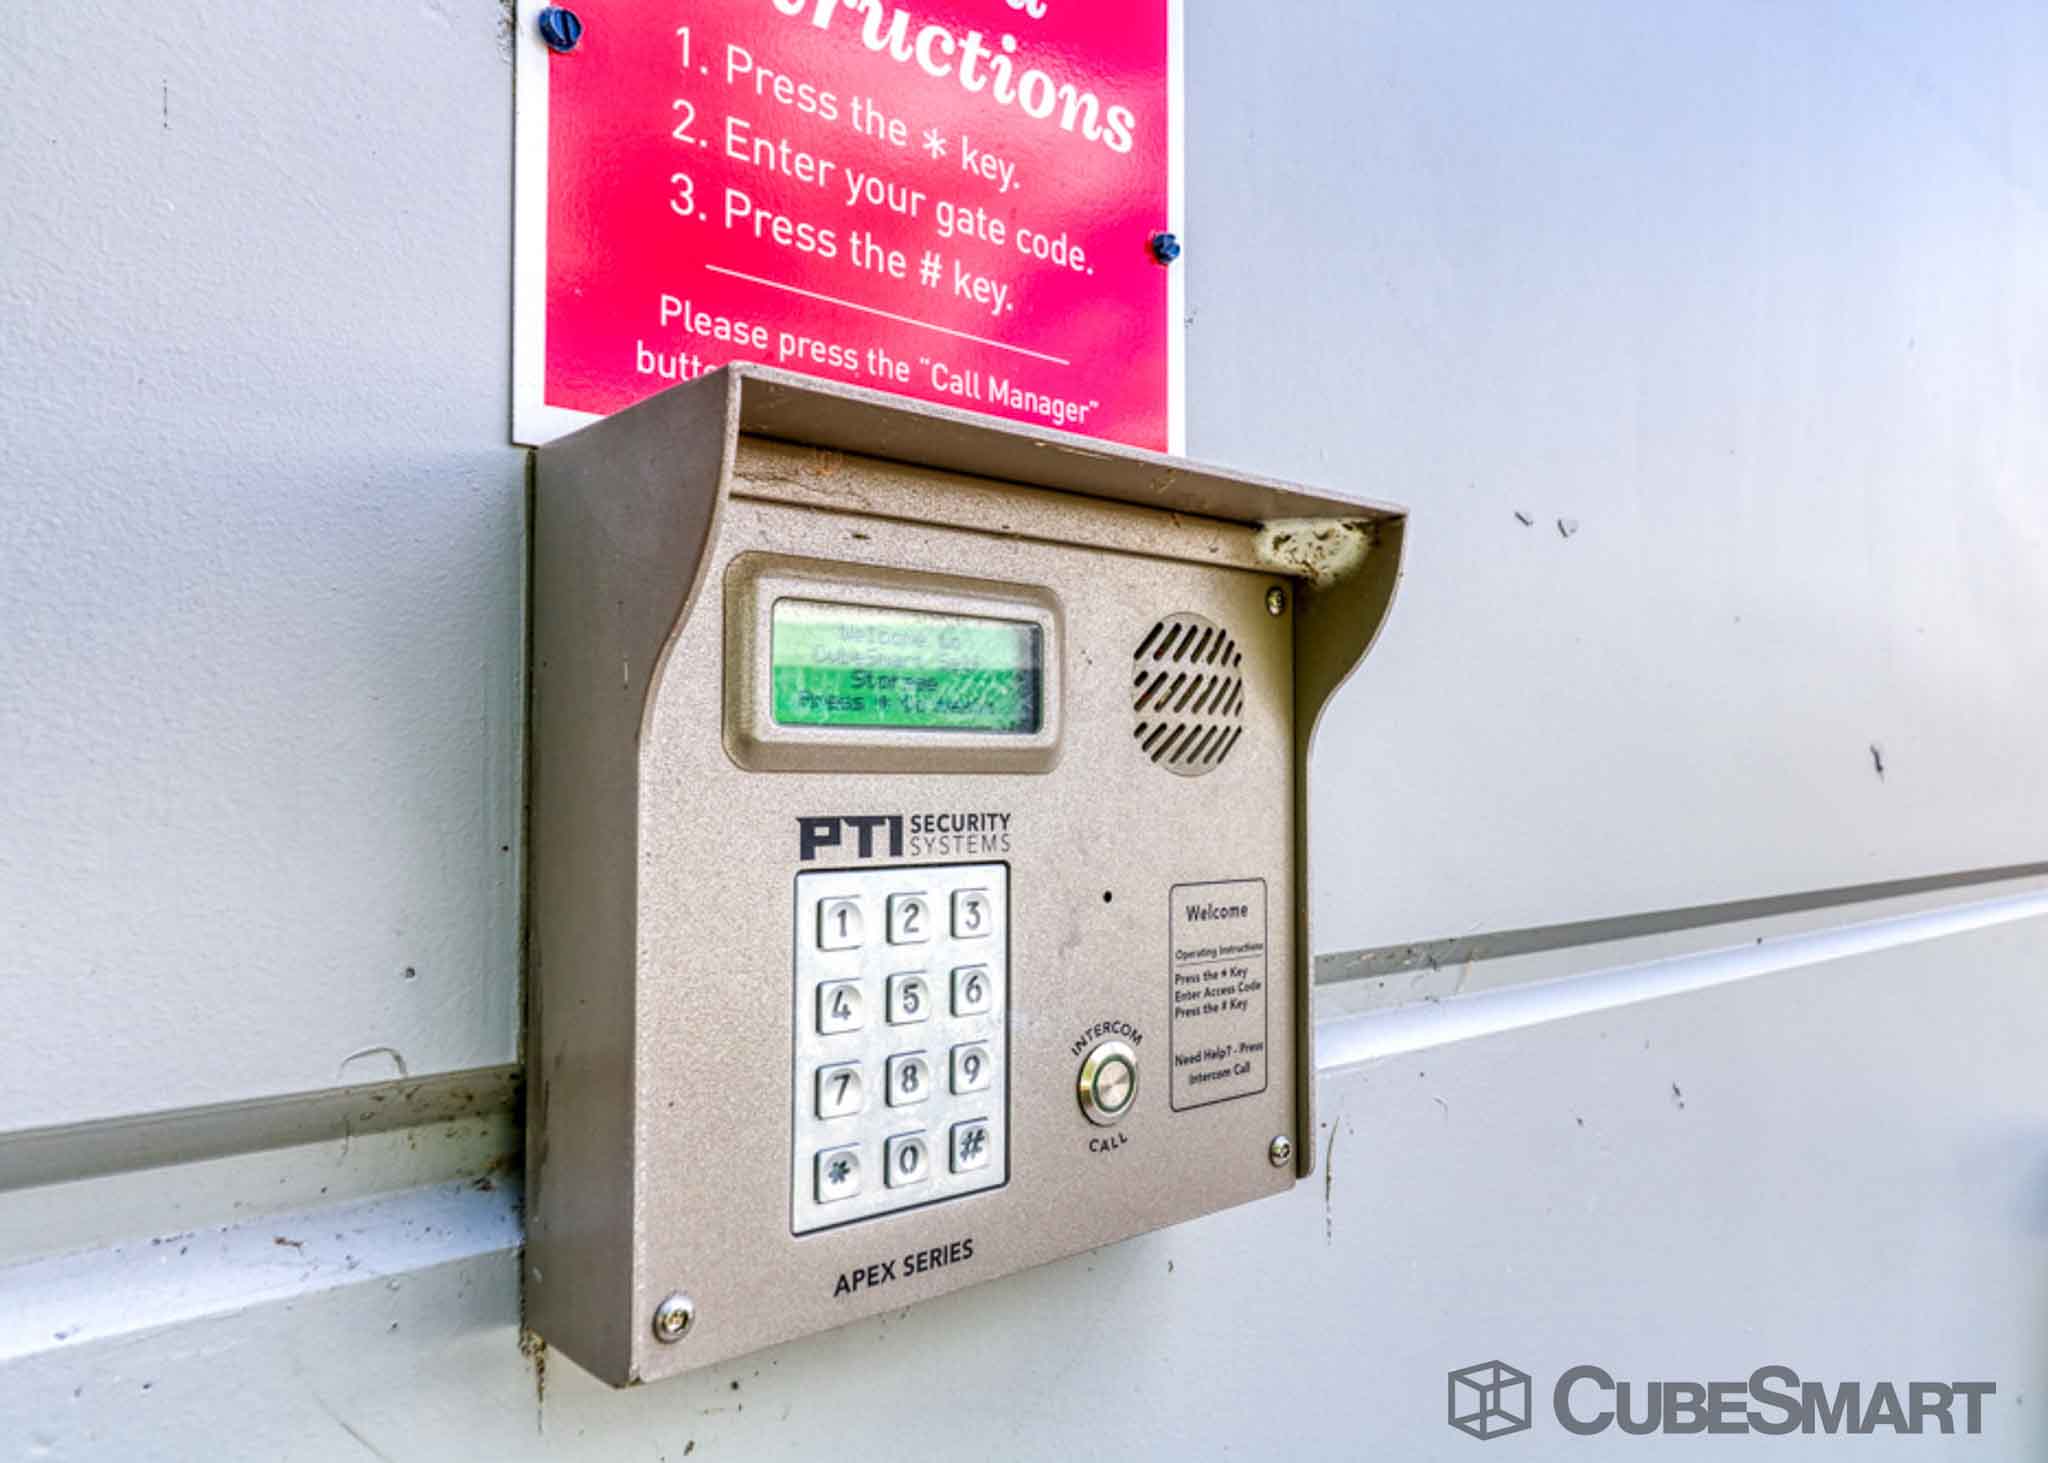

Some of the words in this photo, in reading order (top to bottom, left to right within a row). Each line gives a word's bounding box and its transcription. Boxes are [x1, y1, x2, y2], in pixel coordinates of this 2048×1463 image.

[676, 26, 709, 75] 1.
[726, 44, 838, 120] Press
[850, 96, 908, 146] the
[961, 135, 1020, 192] key.
[672, 99, 707, 147] 2.
[725, 115, 836, 187] Enter
[845, 167, 926, 217] your
[935, 200, 1006, 245] gate
[1016, 231, 1094, 275] code.
[670, 173, 707, 222] 3.
[725, 187, 838, 258] Press
[849, 231, 907, 278] the
[920, 250, 943, 288] #
[954, 258, 1014, 316] key.
[660, 293, 769, 350] Please
[779, 331, 859, 372] press
[867, 348, 911, 382] the
[796, 815, 903, 861] PTI
[910, 812, 1012, 835] SECURITY
[910, 833, 1012, 857] SYSTEMS
[836, 908, 848, 938] 1
[902, 903, 920, 933] 2
[964, 900, 982, 930] 3
[1185, 902, 1249, 922] Welcome
[1175, 947, 1218, 961] Operating
[1219, 942, 1264, 956] Instructions
[1174, 973, 1201, 986] Press
[1202, 969, 1219, 982] the
[1230, 966, 1249, 980] Key
[1174, 989, 1201, 1003] Enter
[1203, 986, 1236, 999] Access
[1238, 979, 1262, 993] Code
[831, 989, 852, 1020] 4
[902, 983, 920, 1014] 5
[965, 975, 983, 1004] 6
[1174, 1006, 1201, 1019] Press
[1202, 1001, 1219, 1014] the
[1230, 997, 1249, 1012] Key
[1071, 1020, 1143, 1057] INTERCOM
[1174, 1050, 1201, 1067] Need
[1203, 1044, 1232, 1062] Help?
[1240, 1041, 1264, 1054] Press
[833, 1073, 851, 1107] 7
[901, 1064, 919, 1094] 8
[963, 1054, 982, 1084] 9
[1188, 1068, 1232, 1086] Intercom
[1234, 1060, 1251, 1076] Call
[899, 1144, 919, 1175] 0
[959, 1128, 985, 1162] #
[1089, 1131, 1128, 1153] CALL
[833, 1260, 896, 1298] APEX
[903, 1238, 975, 1278] SERIES
